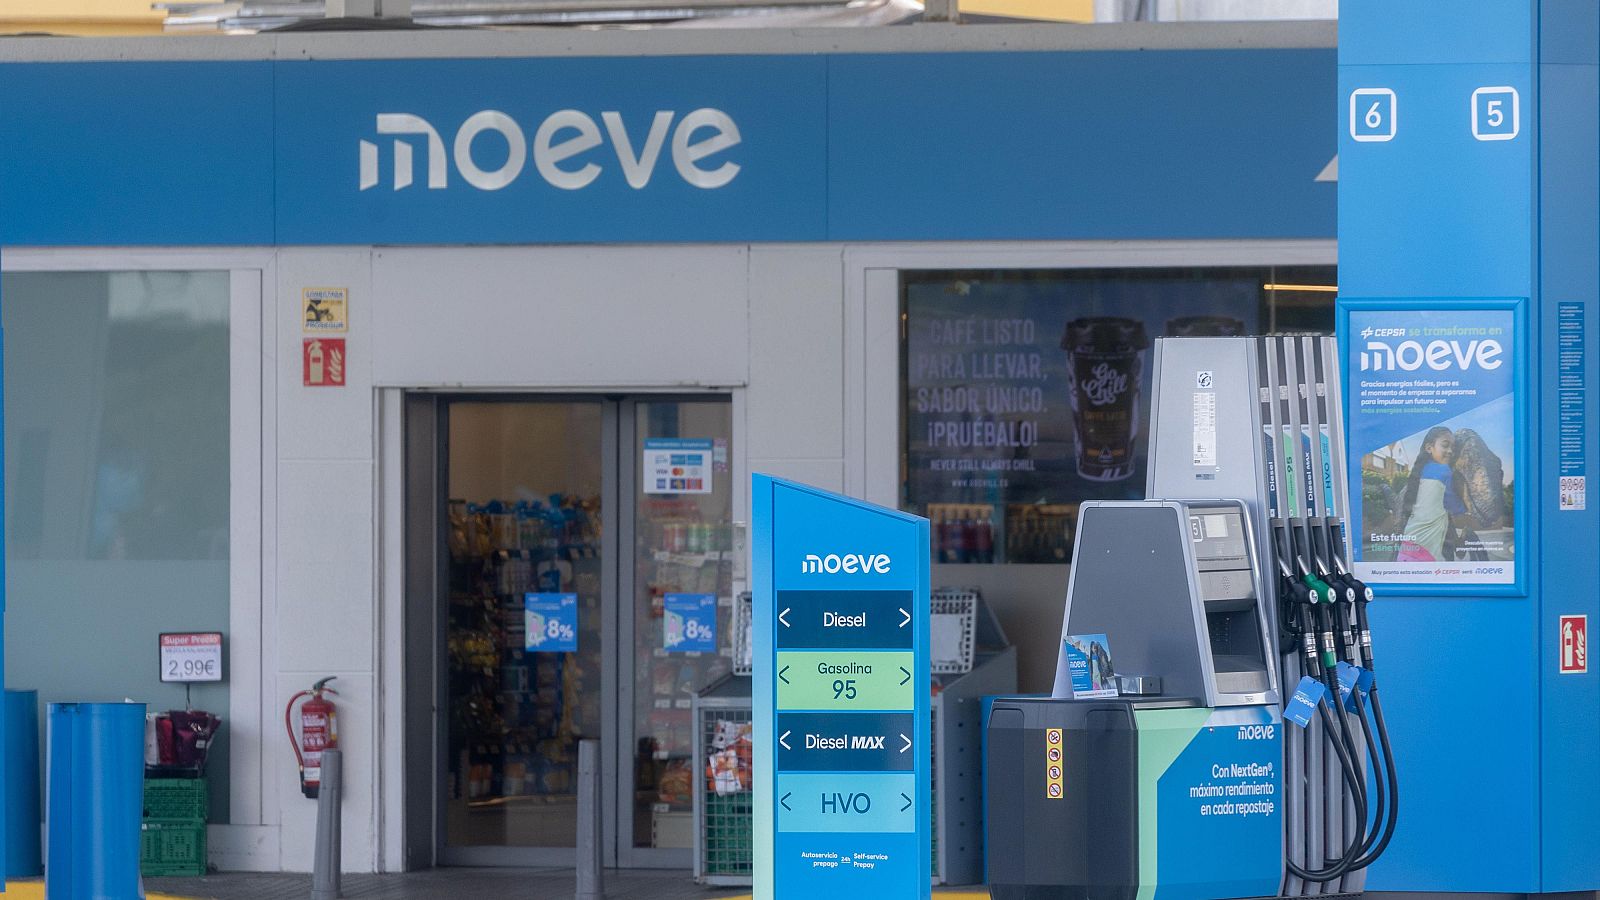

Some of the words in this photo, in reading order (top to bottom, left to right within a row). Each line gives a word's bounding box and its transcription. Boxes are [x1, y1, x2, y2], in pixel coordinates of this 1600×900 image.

[1365, 102, 1382, 129] 6
[1487, 100, 1504, 127] 5
[359, 107, 742, 191] moeve
[930, 315, 977, 345] CAFÉ
[983, 319, 1035, 345] LISTO
[1375, 328, 1406, 337] CEPSA
[1408, 329, 1420, 337] se
[1423, 326, 1486, 337] transforma
[1489, 328, 1503, 336] en
[1360, 339, 1503, 371] moeve
[918, 354, 967, 380] PARA
[972, 353, 1048, 382] LLEVAR,
[1081, 372, 1127, 405] Chill
[1360, 380, 1385, 388] Gracias
[917, 387, 983, 413] SABOR
[986, 383, 1048, 413] ÚNICO.
[1360, 398, 1377, 406] para
[1377, 397, 1405, 406] impulsar
[1414, 397, 1434, 405] futuro
[1407, 389, 1435, 398] empezar
[1441, 389, 1477, 397] separarnos
[928, 417, 1039, 447] ¡PRUÉBALO!
[930, 459, 957, 471] NEVER
[958, 459, 979, 471] STILL
[981, 459, 1011, 471] ALWAYS
[1012, 459, 1036, 471] CHILL
[1286, 456, 1293, 473] 95
[1268, 461, 1276, 491] Diesel
[1306, 471, 1314, 501] Diesel
[1192, 523, 1199, 536] 5
[1371, 533, 1390, 542] Este
[1391, 533, 1417, 542] futuro
[1371, 543, 1393, 552] tiene
[802, 553, 891, 574] moeve
[1475, 567, 1503, 575] moeve
[823, 611, 866, 627] Diesel
[547, 619, 574, 639] 8%
[686, 619, 713, 639] 8%
[164, 636, 188, 646] Super
[191, 635, 218, 643] Precio
[168, 659, 215, 678] 2,99€
[817, 661, 872, 674] Gasolina
[832, 679, 857, 700] 95
[1293, 694, 1315, 708] moeve
[1237, 724, 1274, 740] moeve
[805, 734, 848, 749] Diesel
[851, 736, 886, 749] MAX
[1212, 763, 1230, 778] Con
[1190, 782, 1224, 798] máximo
[1225, 780, 1275, 796] rendimiento
[821, 792, 871, 814] HVO
[1200, 804, 1212, 816] en
[1212, 800, 1234, 815] cada
[1235, 799, 1275, 817] repostaje
[801, 851, 838, 859] Autoservicio
[853, 852, 889, 861] Self-service
[853, 861, 875, 869] Prepay
